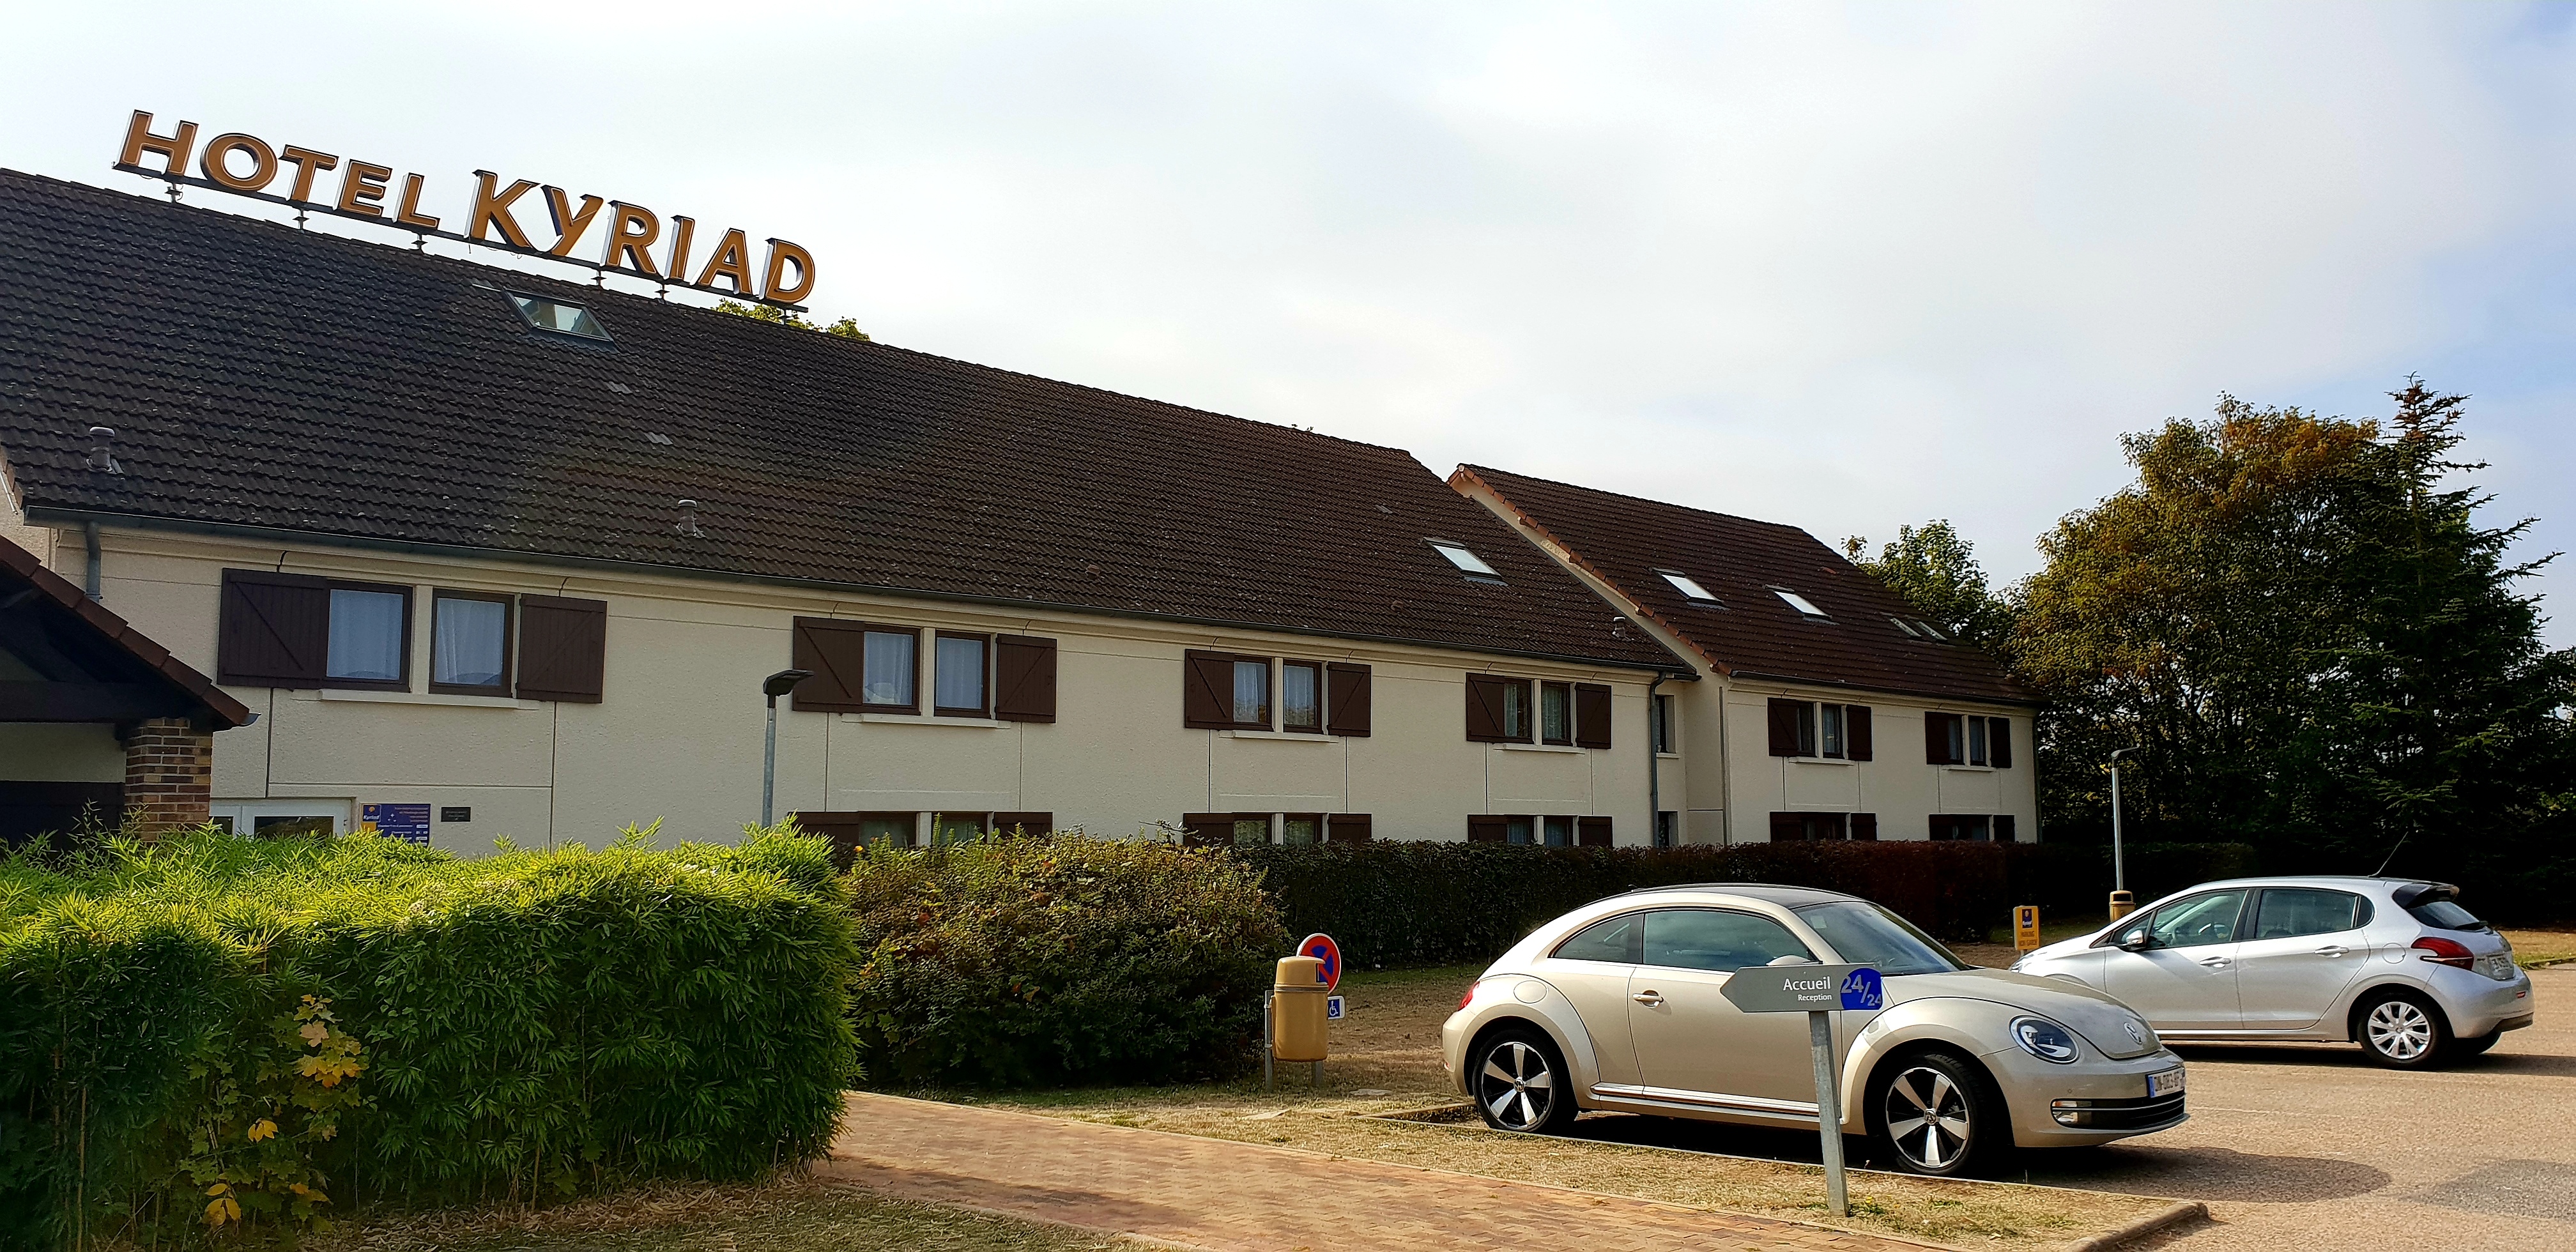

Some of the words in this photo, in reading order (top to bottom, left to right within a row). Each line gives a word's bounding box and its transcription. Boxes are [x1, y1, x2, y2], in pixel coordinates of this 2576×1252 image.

[116, 109, 441, 230] HOTEL
[464, 169, 816, 305] KYRIAD
[1782, 976, 1831, 991] Accueil
[1798, 994, 1832, 1002] Reception
